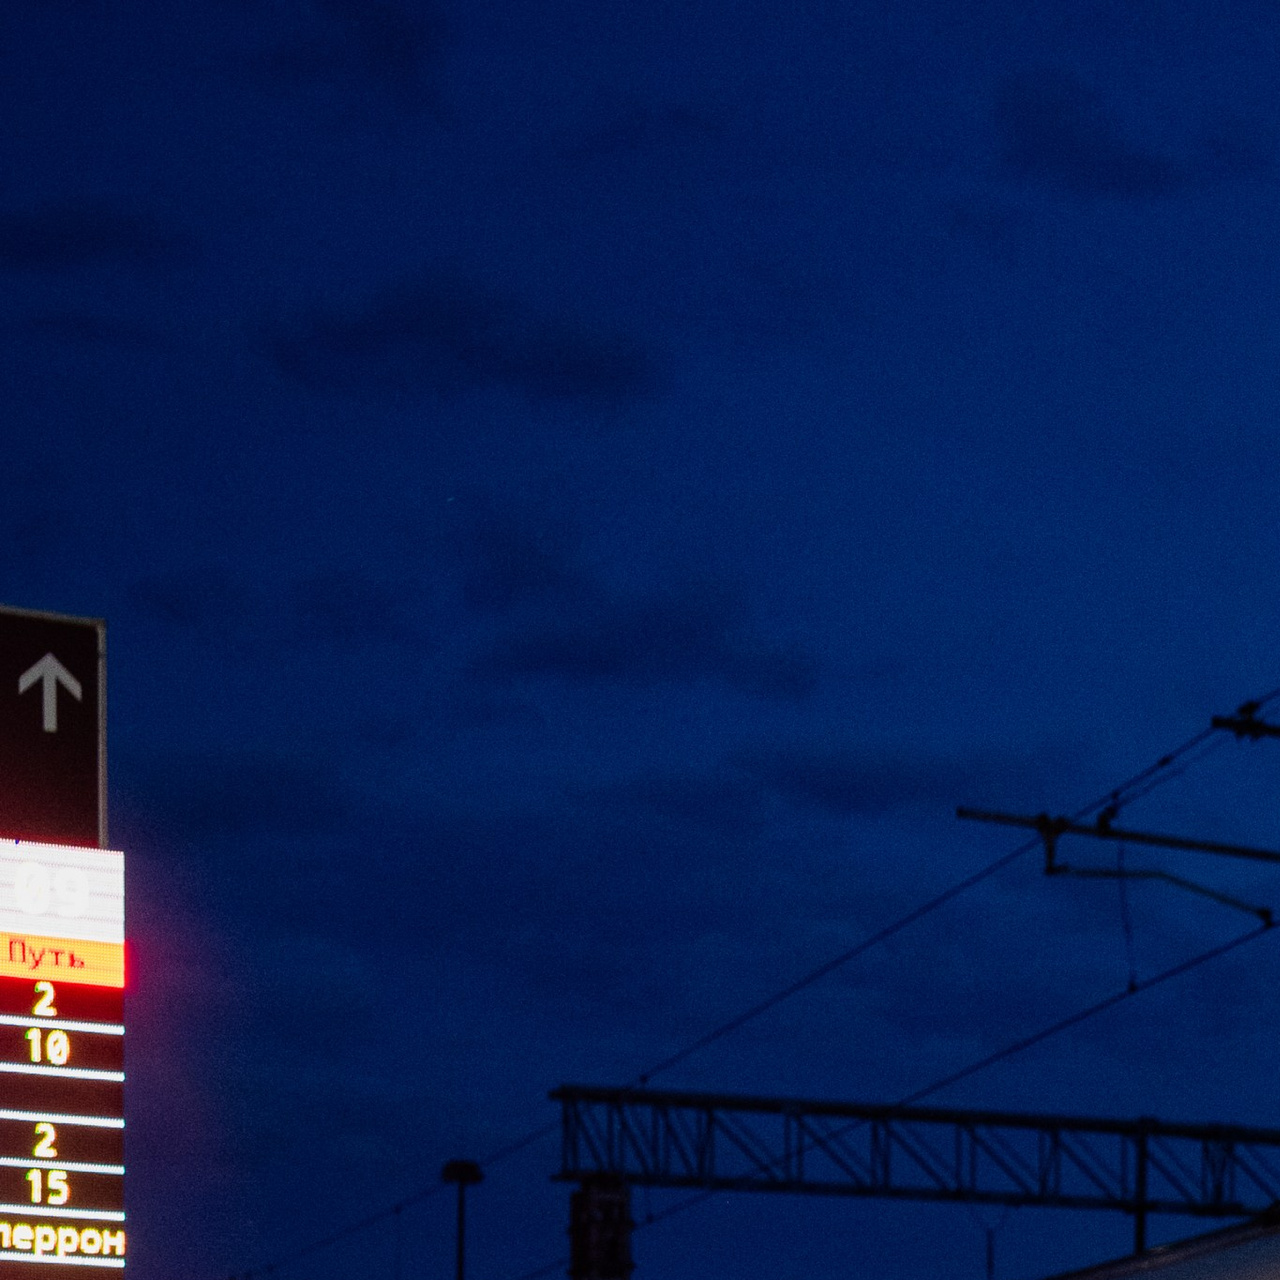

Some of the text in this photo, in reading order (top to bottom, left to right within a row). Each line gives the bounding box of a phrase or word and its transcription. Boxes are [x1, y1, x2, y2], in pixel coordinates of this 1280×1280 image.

[9, 937, 85, 970] Путь
[32, 980, 58, 1017] 2
[25, 1027, 70, 1066] 10
[32, 1121, 58, 1158] 2
[25, 1168, 71, 1206] 15
